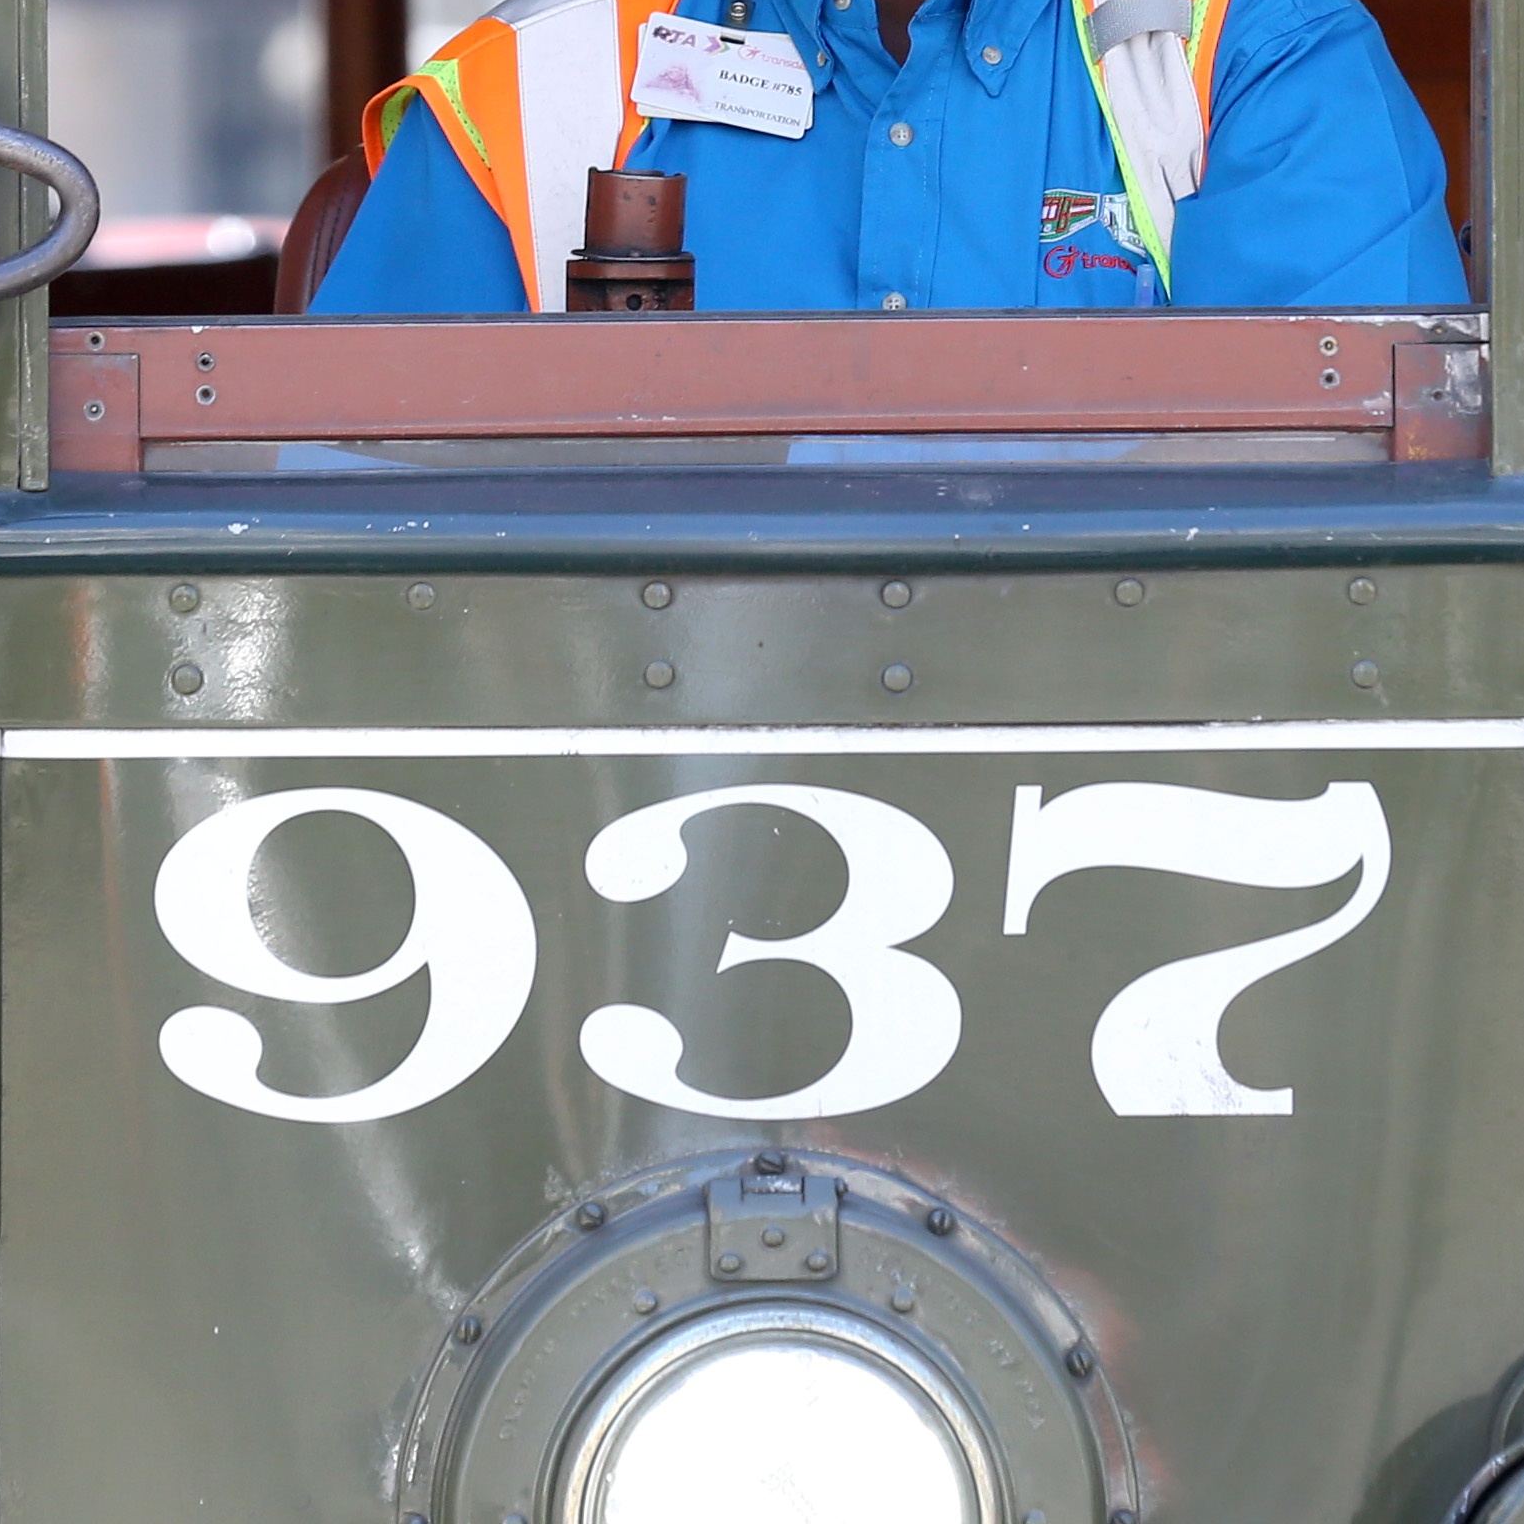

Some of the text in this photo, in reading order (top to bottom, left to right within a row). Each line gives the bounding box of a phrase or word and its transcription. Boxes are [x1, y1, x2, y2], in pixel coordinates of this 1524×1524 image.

[653, 26, 695, 46] RTA
[719, 70, 802, 96] BADGE #785
[715, 101, 800, 126] TRANSPORTATION
[154, 782, 1391, 1123] 937
